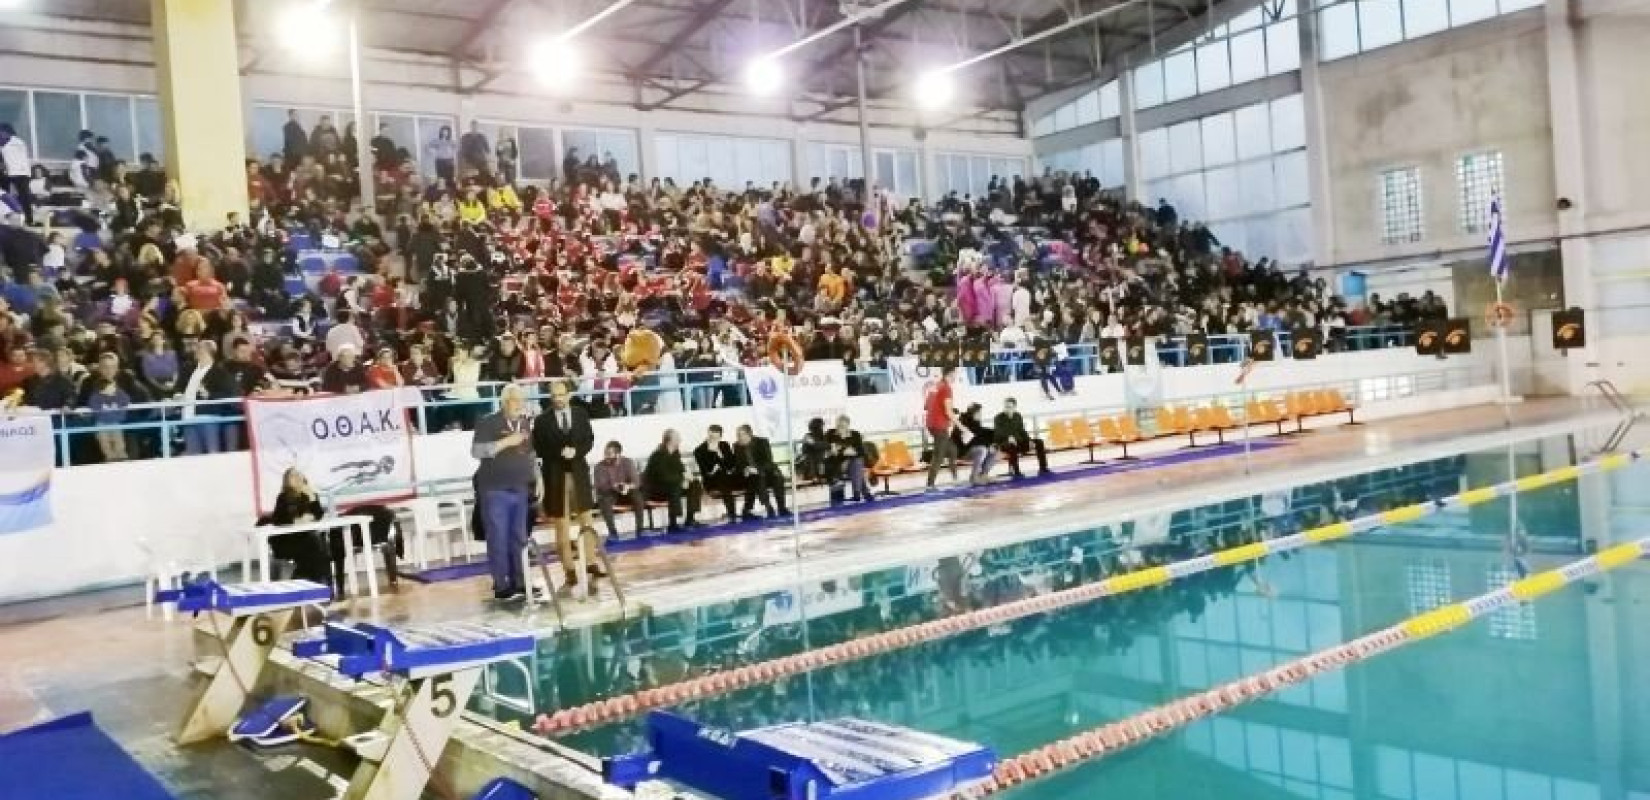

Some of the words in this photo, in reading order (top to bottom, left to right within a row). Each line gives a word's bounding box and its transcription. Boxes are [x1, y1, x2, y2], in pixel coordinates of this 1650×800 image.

[312, 408, 400, 439] Ο.Θ.Α.Κ.
[252, 612, 275, 647] 6
[431, 671, 456, 718] 5
